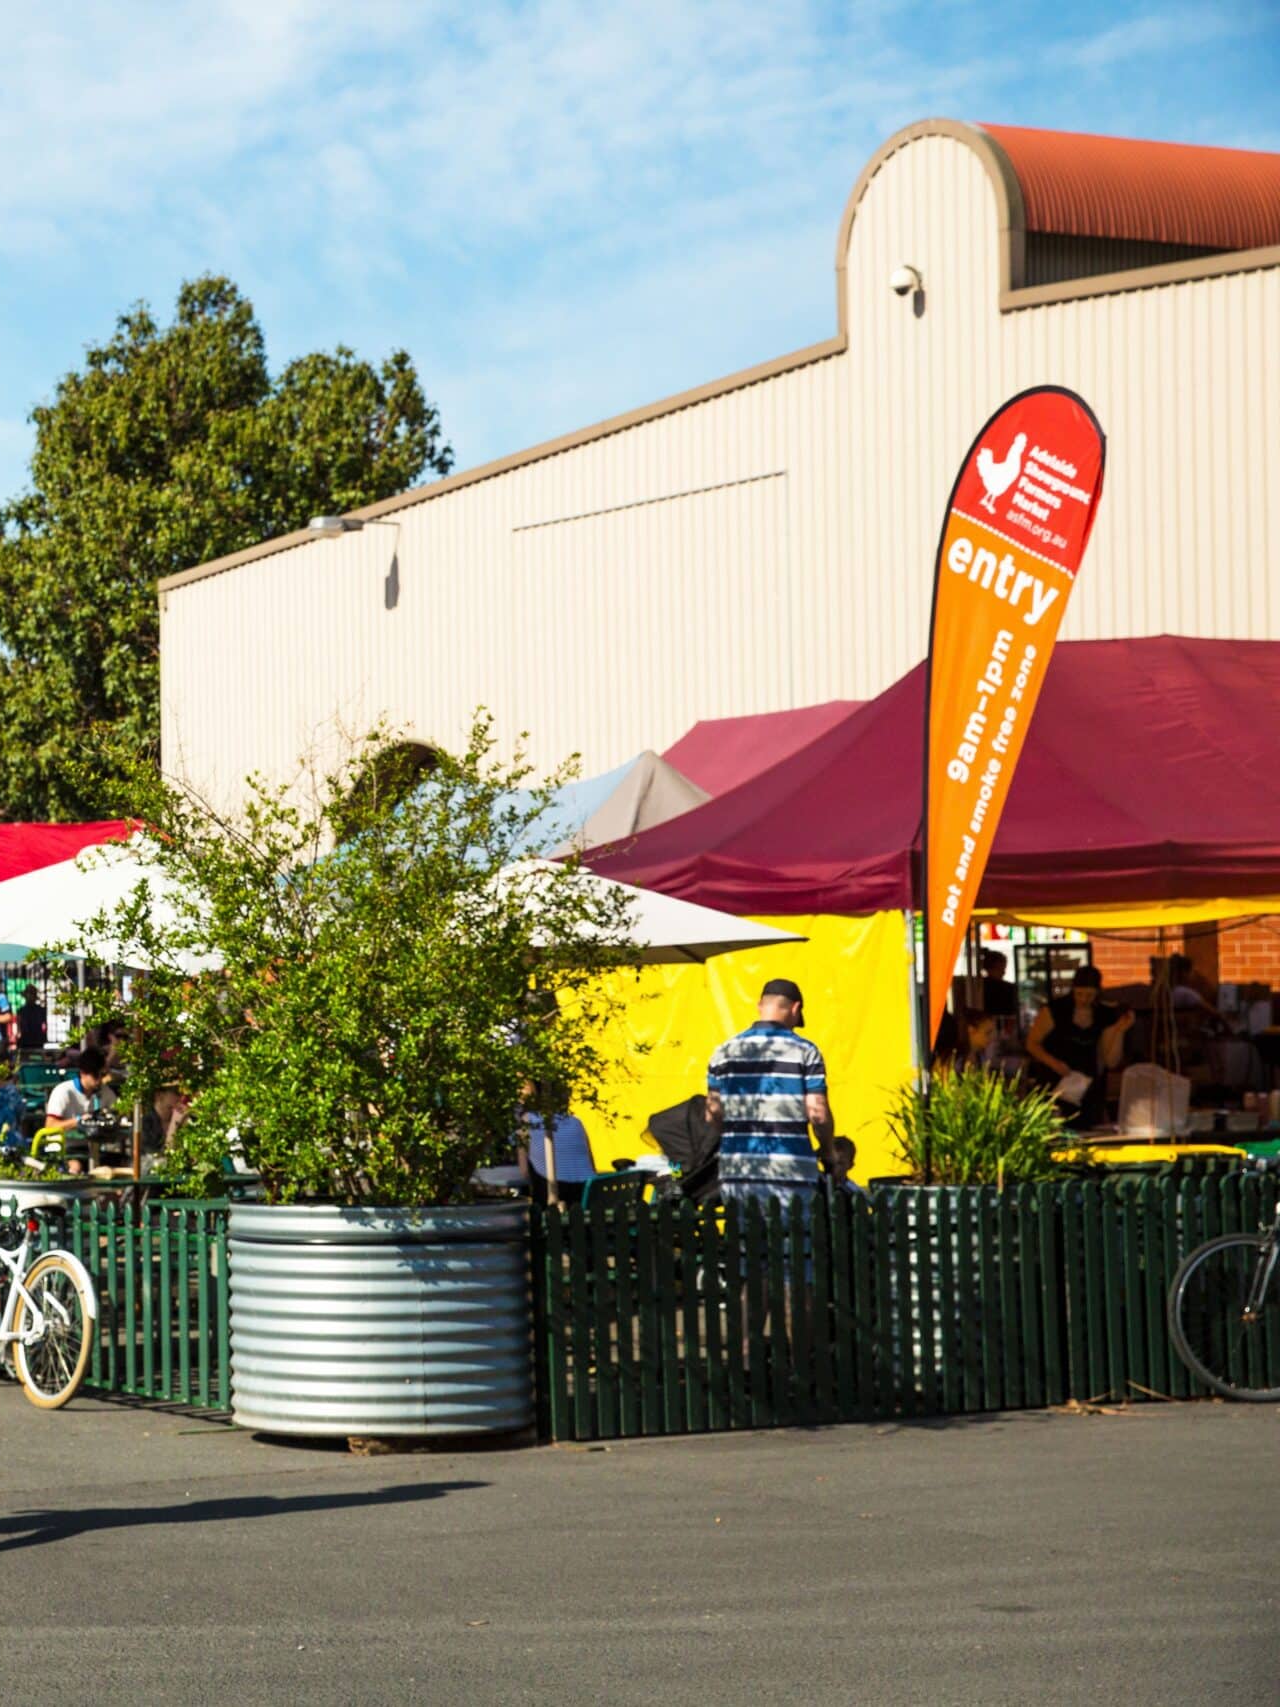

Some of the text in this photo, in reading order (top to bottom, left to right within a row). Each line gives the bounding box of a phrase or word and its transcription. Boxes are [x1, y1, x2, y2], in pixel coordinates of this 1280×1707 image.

[947, 537, 1060, 626] entry
[946, 629, 1014, 784] 9am-1pm
[941, 644, 1037, 926] pet and smoke free zone
